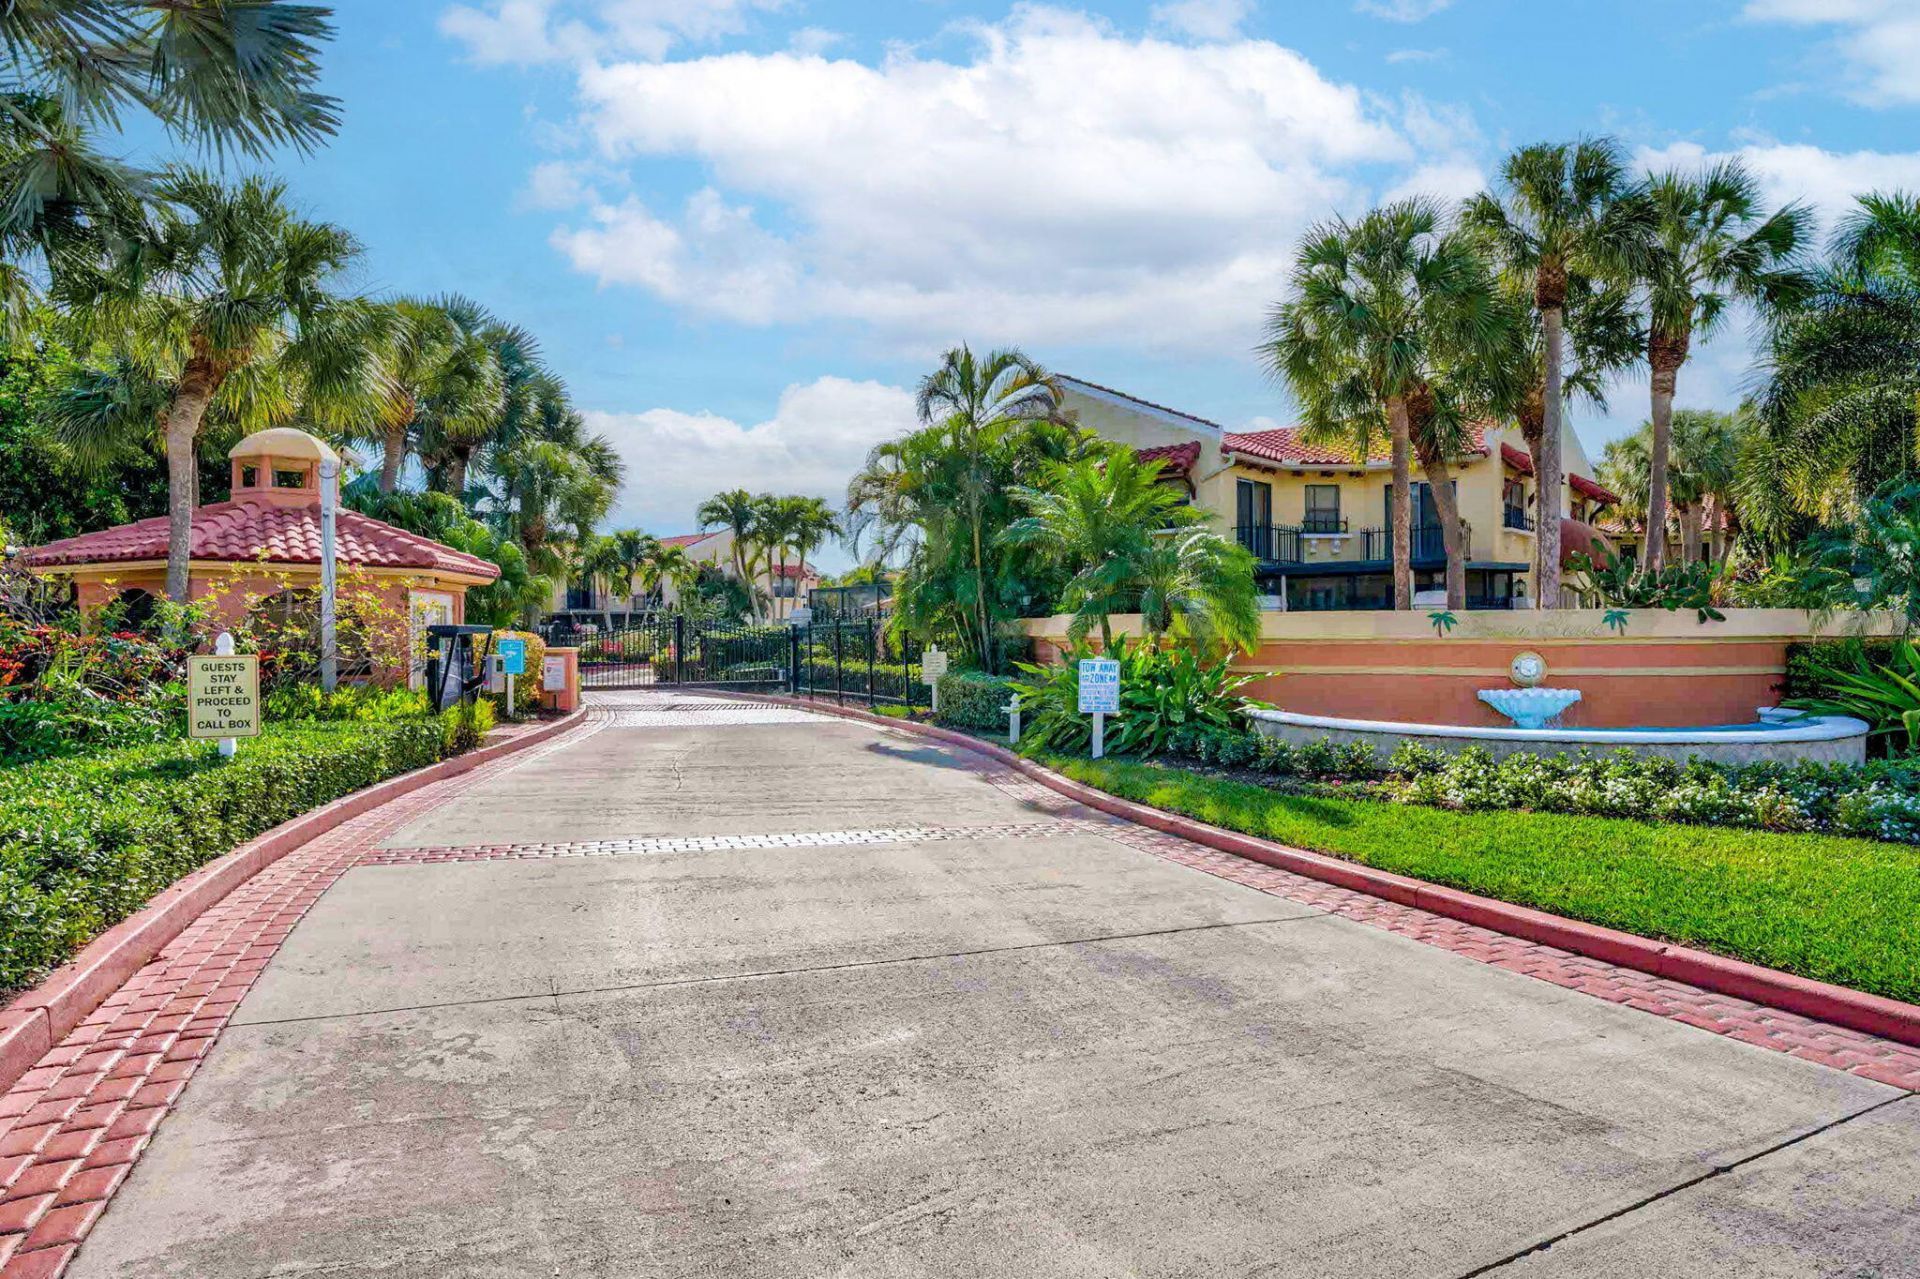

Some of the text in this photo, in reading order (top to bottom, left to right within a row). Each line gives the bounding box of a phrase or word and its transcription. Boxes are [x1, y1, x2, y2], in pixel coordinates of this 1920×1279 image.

[201, 663, 245, 672] GUESTS
[1082, 662, 1117, 672] TOW AWAY
[210, 674, 237, 683] STAY
[1090, 673, 1108, 683] ZONE
[204, 685, 244, 695] LEFT &
[197, 696, 251, 706] PROCEED
[217, 708, 231, 717] TO
[197, 720, 251, 729] CALL BOX
